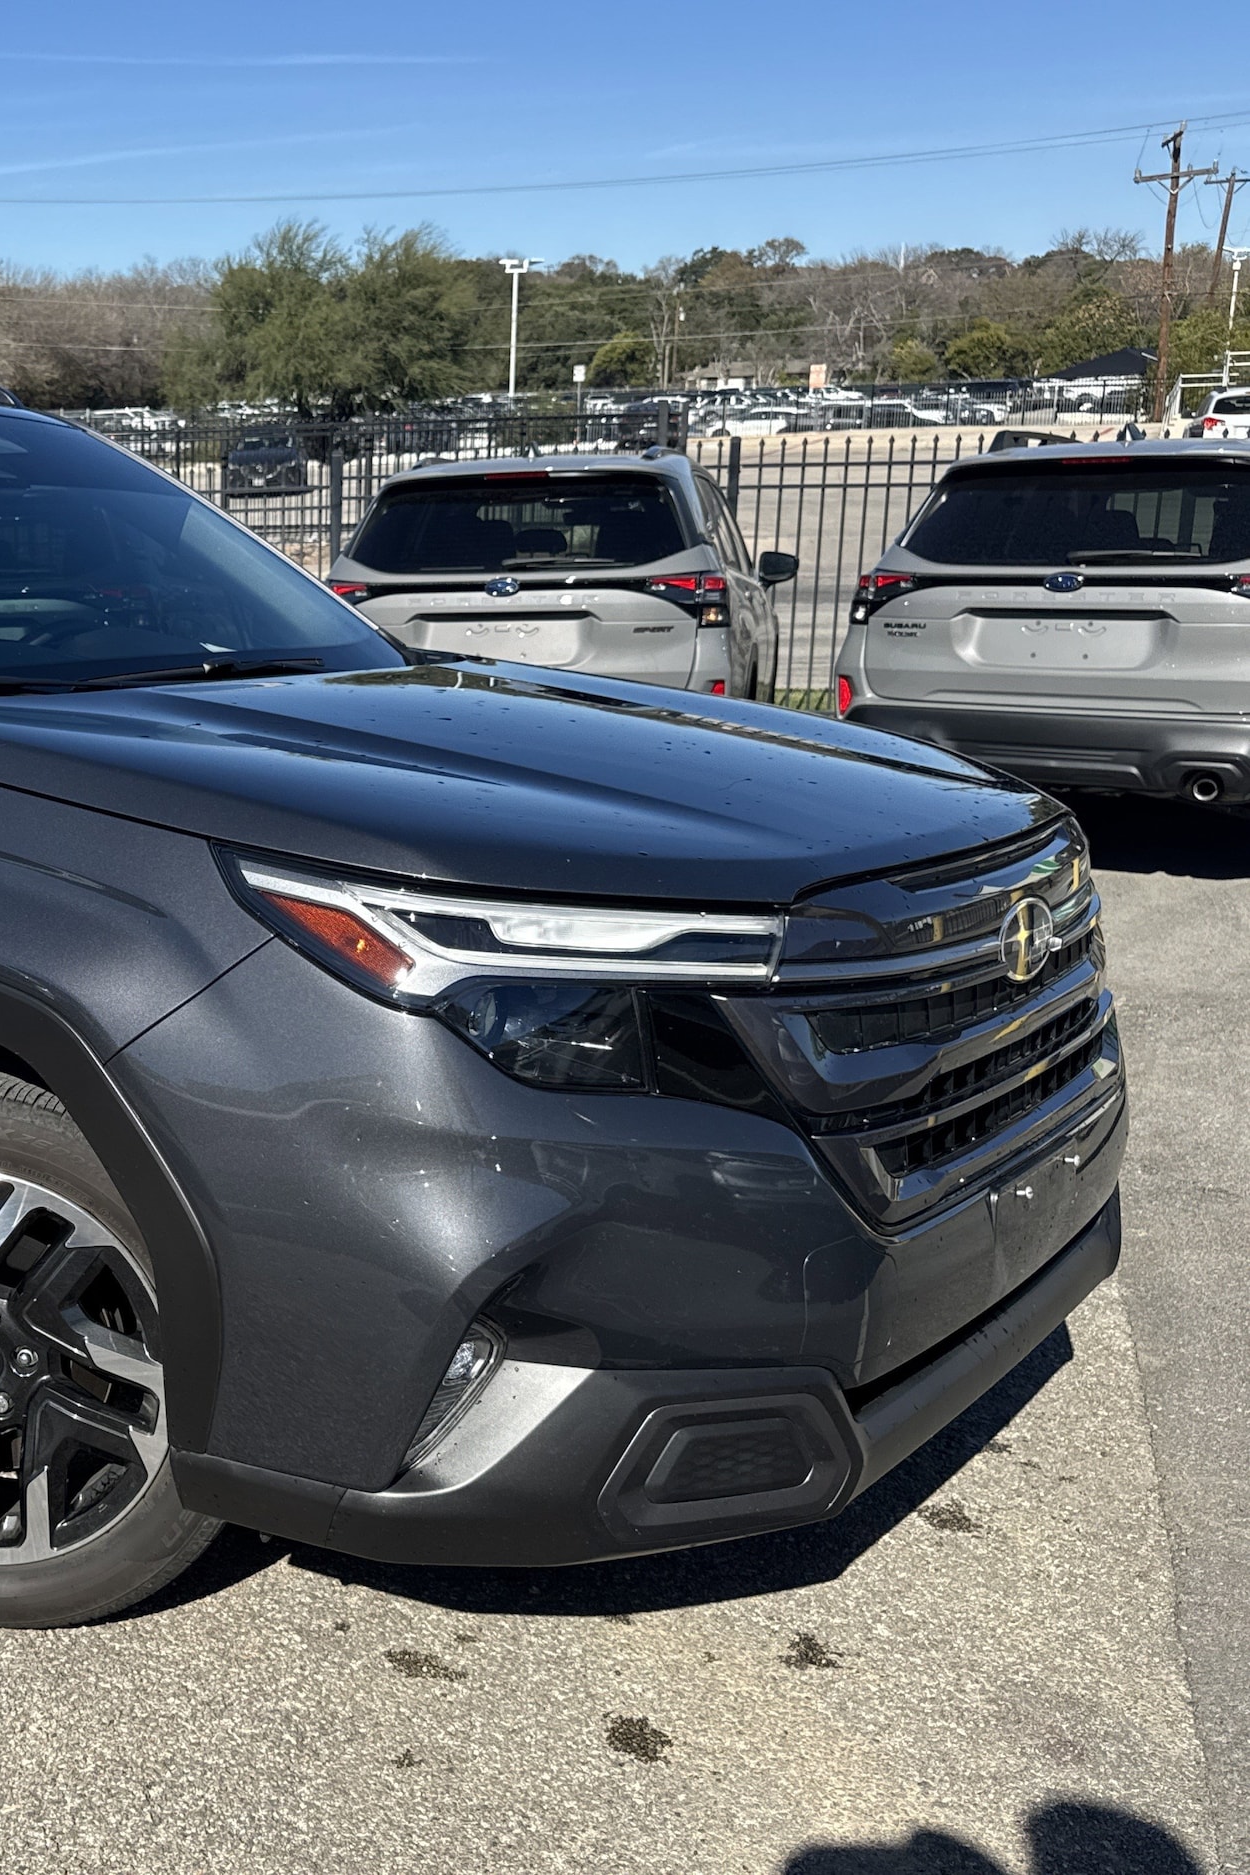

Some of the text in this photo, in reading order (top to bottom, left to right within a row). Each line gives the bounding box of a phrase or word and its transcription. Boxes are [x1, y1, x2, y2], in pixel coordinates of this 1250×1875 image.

[955, 591, 1177, 603] FORESTER
[632, 625, 675, 634] SPORT
[883, 622, 927, 630] SUBARU
